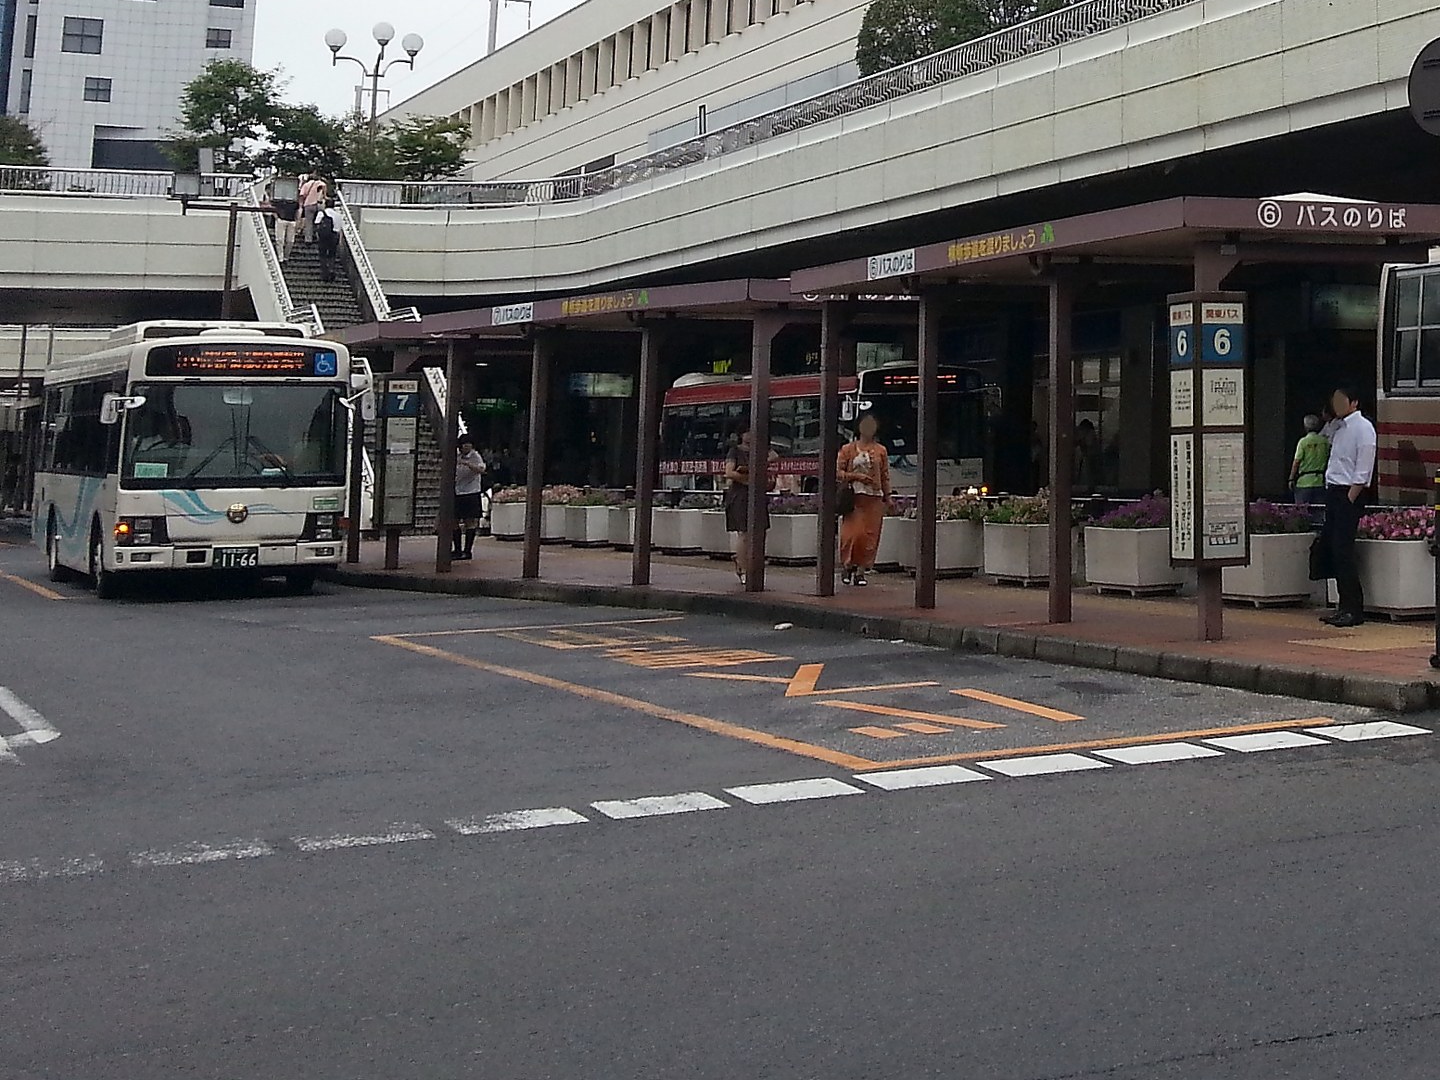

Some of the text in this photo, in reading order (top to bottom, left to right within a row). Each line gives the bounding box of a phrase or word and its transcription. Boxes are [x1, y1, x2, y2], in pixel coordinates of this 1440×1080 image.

[1296, 205, 1406, 228] バスのりば
[1177, 330, 1187, 356] 6
[1214, 328, 1232, 355] 6
[397, 394, 409, 410] 7
